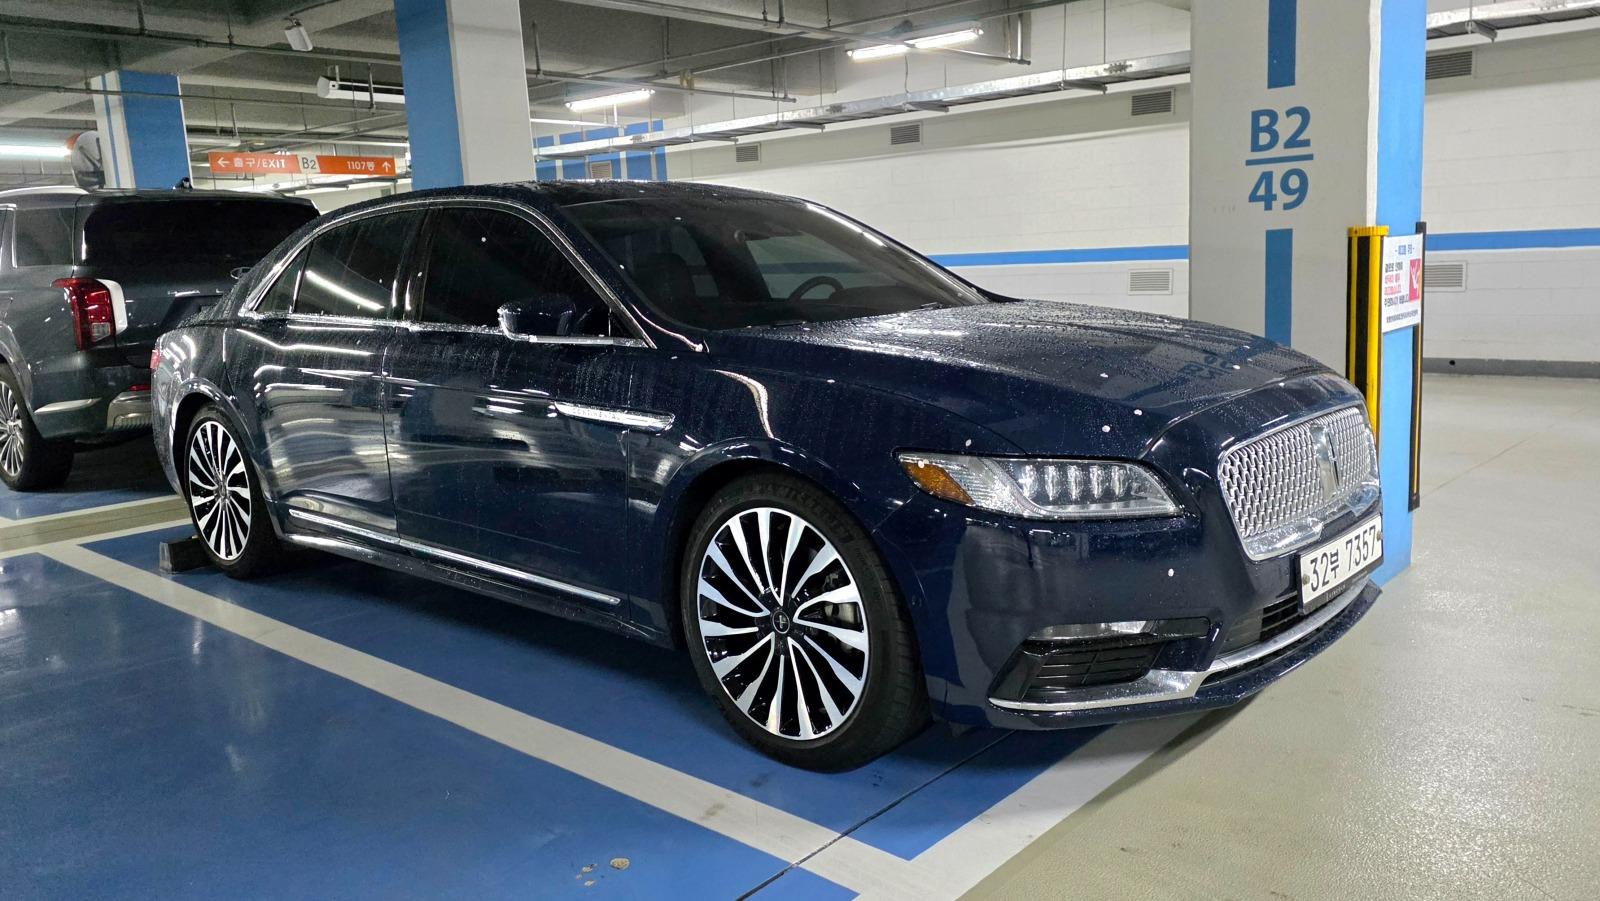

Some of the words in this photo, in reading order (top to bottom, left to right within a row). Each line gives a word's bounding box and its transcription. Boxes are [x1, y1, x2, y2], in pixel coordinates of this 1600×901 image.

[1250, 106, 1311, 152] B2
[302, 157, 317, 170] B2
[1248, 168, 1309, 211] 49
[1310, 548, 1340, 592] 32부
[1345, 524, 1376, 572] 7357
